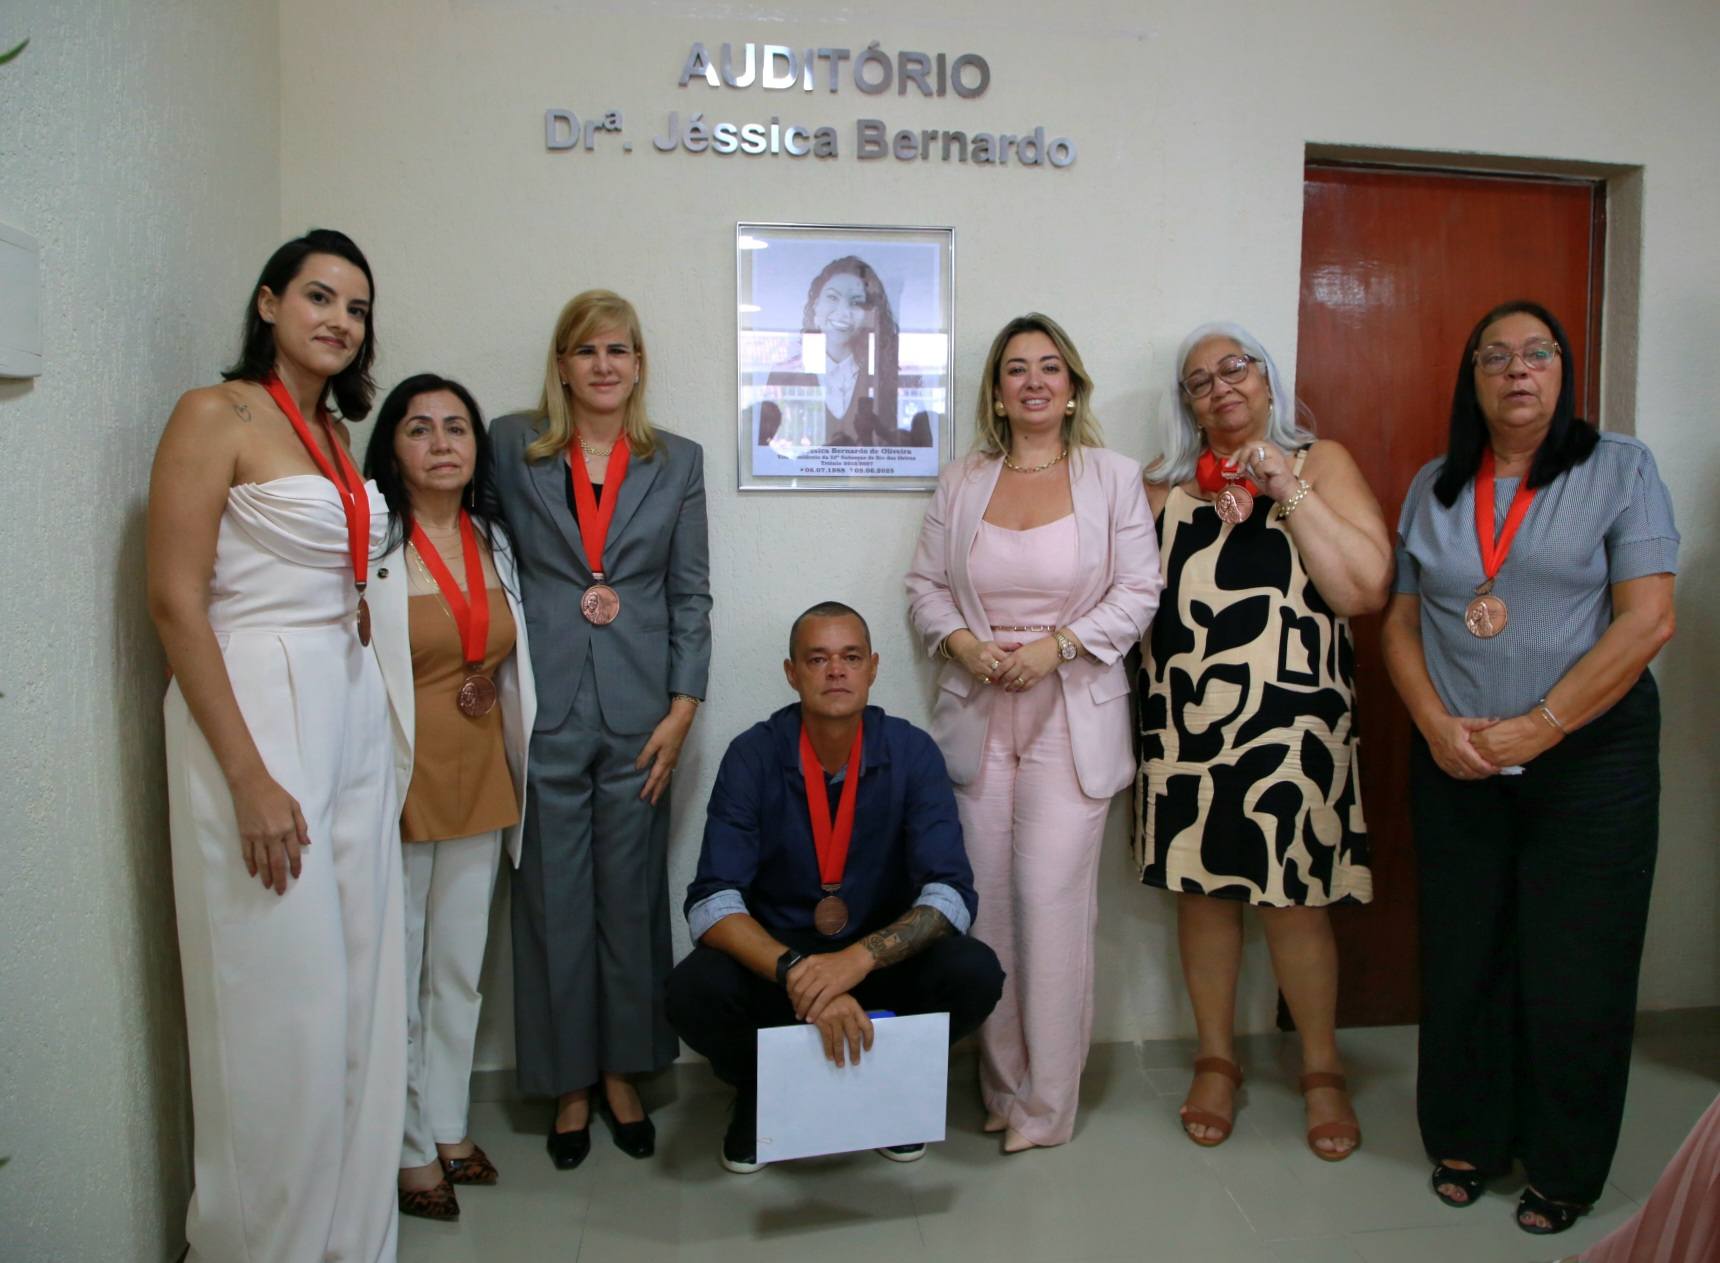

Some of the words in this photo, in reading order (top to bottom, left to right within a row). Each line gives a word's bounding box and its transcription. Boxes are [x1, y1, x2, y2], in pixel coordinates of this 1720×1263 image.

[678, 40, 991, 99] AUDITÓRIO
[653, 111, 839, 158] Jéssica
[856, 118, 1077, 169] Bernardo
